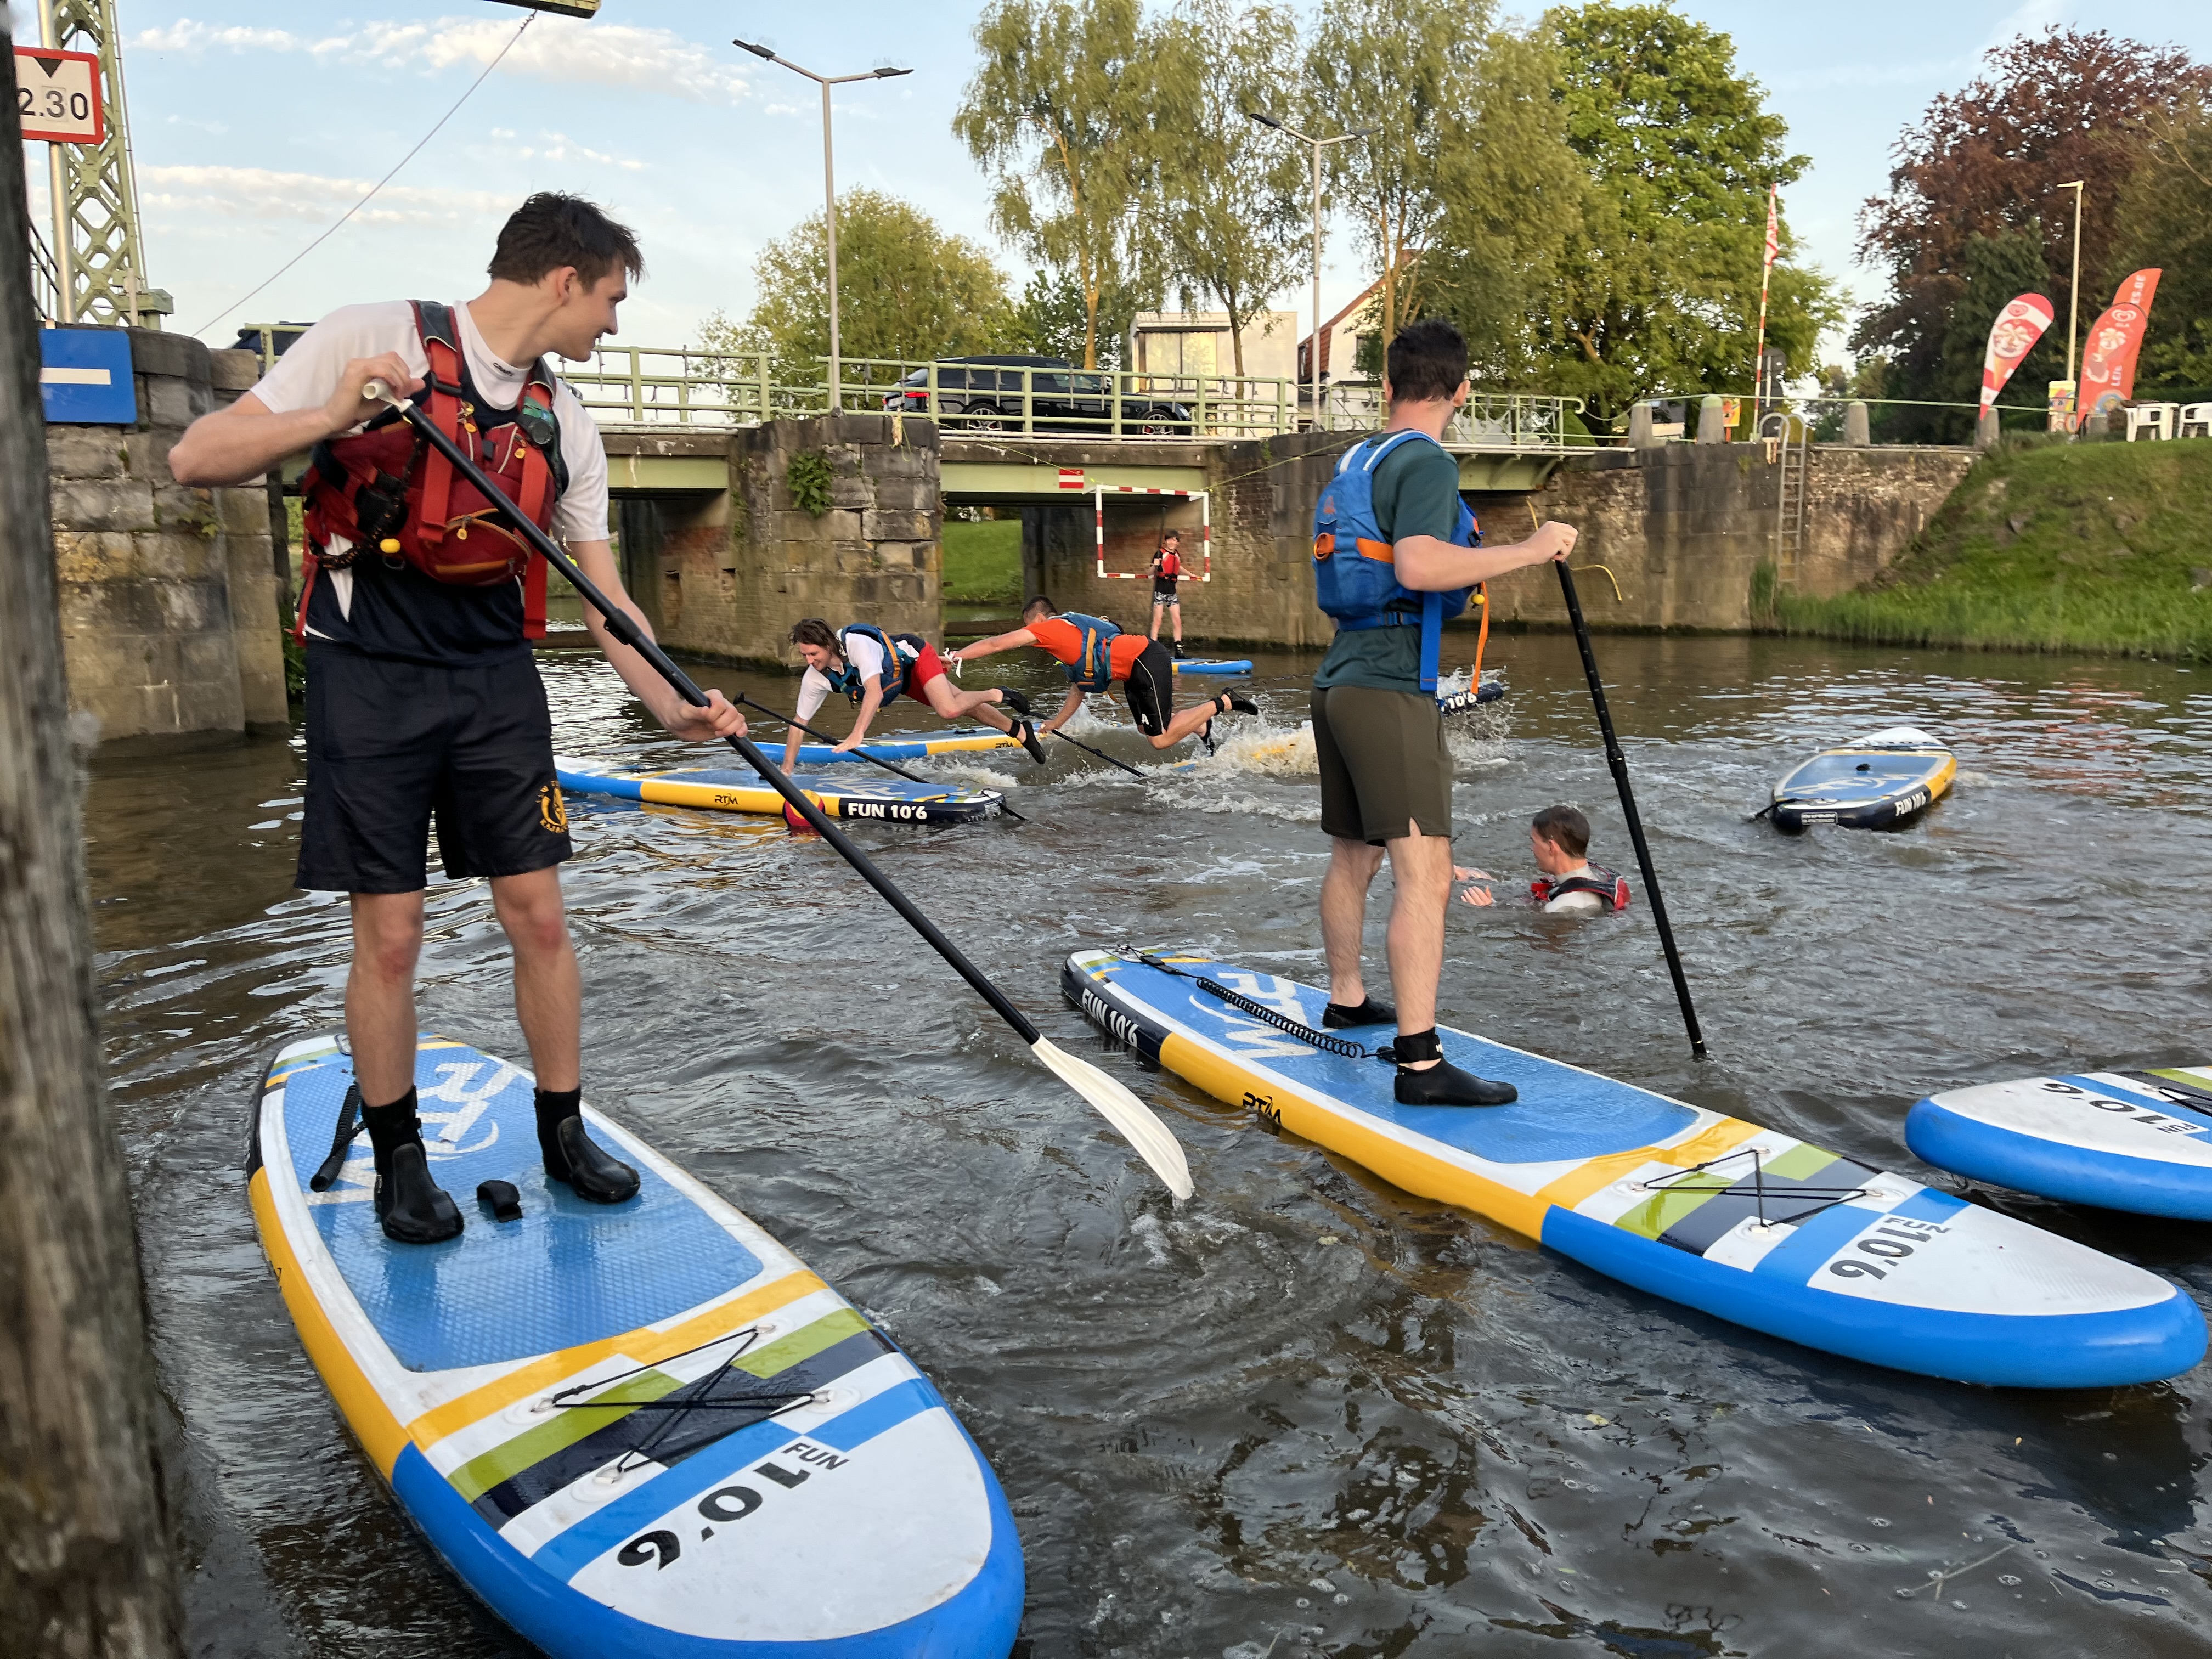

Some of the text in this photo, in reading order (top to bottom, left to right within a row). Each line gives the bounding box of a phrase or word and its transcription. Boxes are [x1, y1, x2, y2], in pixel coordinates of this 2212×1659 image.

[18, 87, 89, 120] 2.30
[714, 793, 738, 806] RTM
[848, 802, 928, 820] FUN 10'6
[1082, 988, 1139, 1048] FUN 10'6
[2038, 1083, 2169, 1124] 10'6
[2155, 1122, 2199, 1134] FUN
[1883, 1217, 1953, 1234] FUN
[1830, 1227, 1932, 1280] 10'6
[781, 1442, 849, 1471] FUN
[617, 1462, 812, 1571] 10'6
